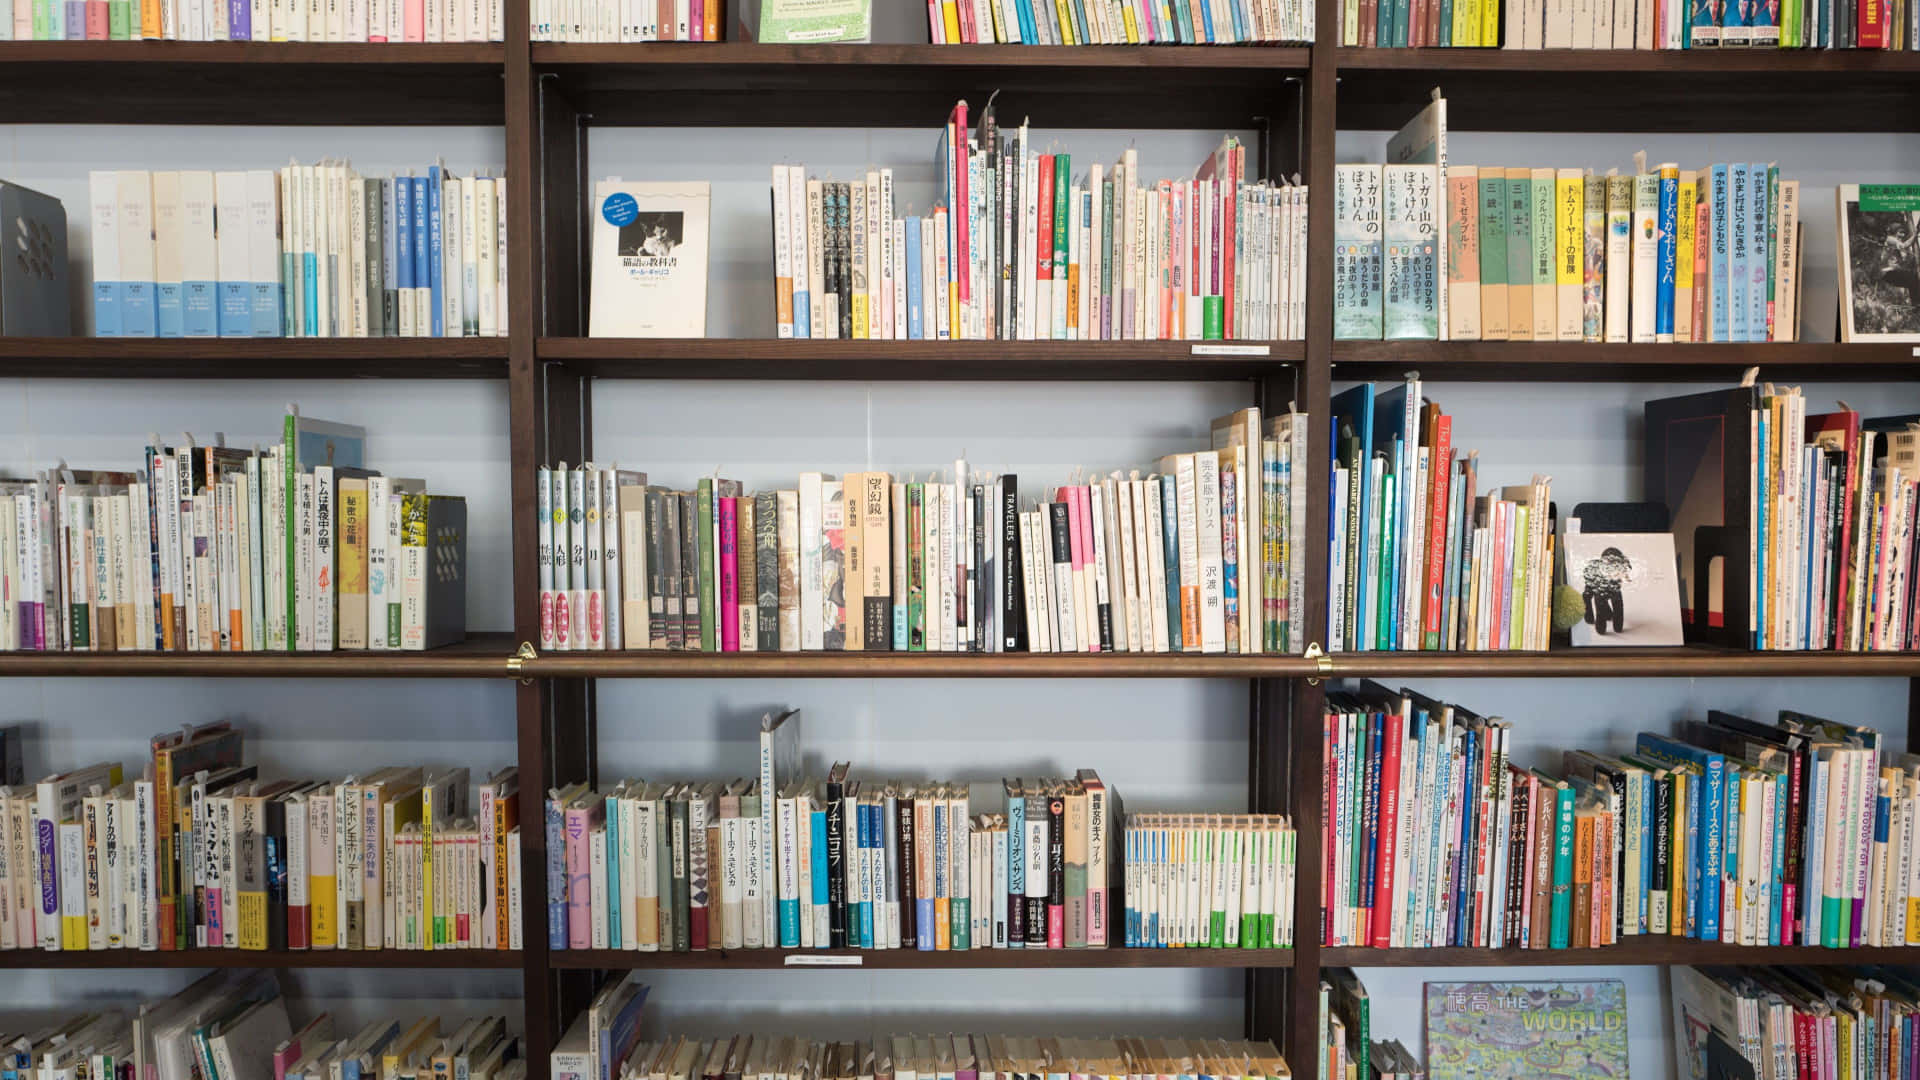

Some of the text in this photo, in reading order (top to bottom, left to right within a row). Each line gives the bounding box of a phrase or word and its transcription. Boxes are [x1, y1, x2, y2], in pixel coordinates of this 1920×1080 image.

[1352, 171, 1364, 222] ぼうけん
[1366, 169, 1379, 234] トガリ山の
[1404, 171, 1416, 223] ぼうけん
[1420, 171, 1432, 234] トガリ山の
[1487, 183, 1497, 224] 三銃士
[1512, 184, 1523, 225] 三銃士
[1566, 185, 1576, 275] トム・ソーヤーの冒険
[1662, 179, 1677, 284] あしながおじさん
[179, 454, 190, 497] 田園の食卓
[1202, 459, 1215, 529] 完全版アリス
[1431, 424, 1450, 579] The Silver Spoon for Children
[303, 484, 311, 536] 木を植えた男
[318, 477, 331, 554] トムは真夜中の庭で
[346, 495, 356, 545] 秘密の花園
[1006, 493, 1015, 541] TRAVELERS
[828, 800, 841, 866] プチ・ニコラ
[1447, 991, 1490, 1012] 穂高
[1496, 996, 1623, 1031] THE WORLD
